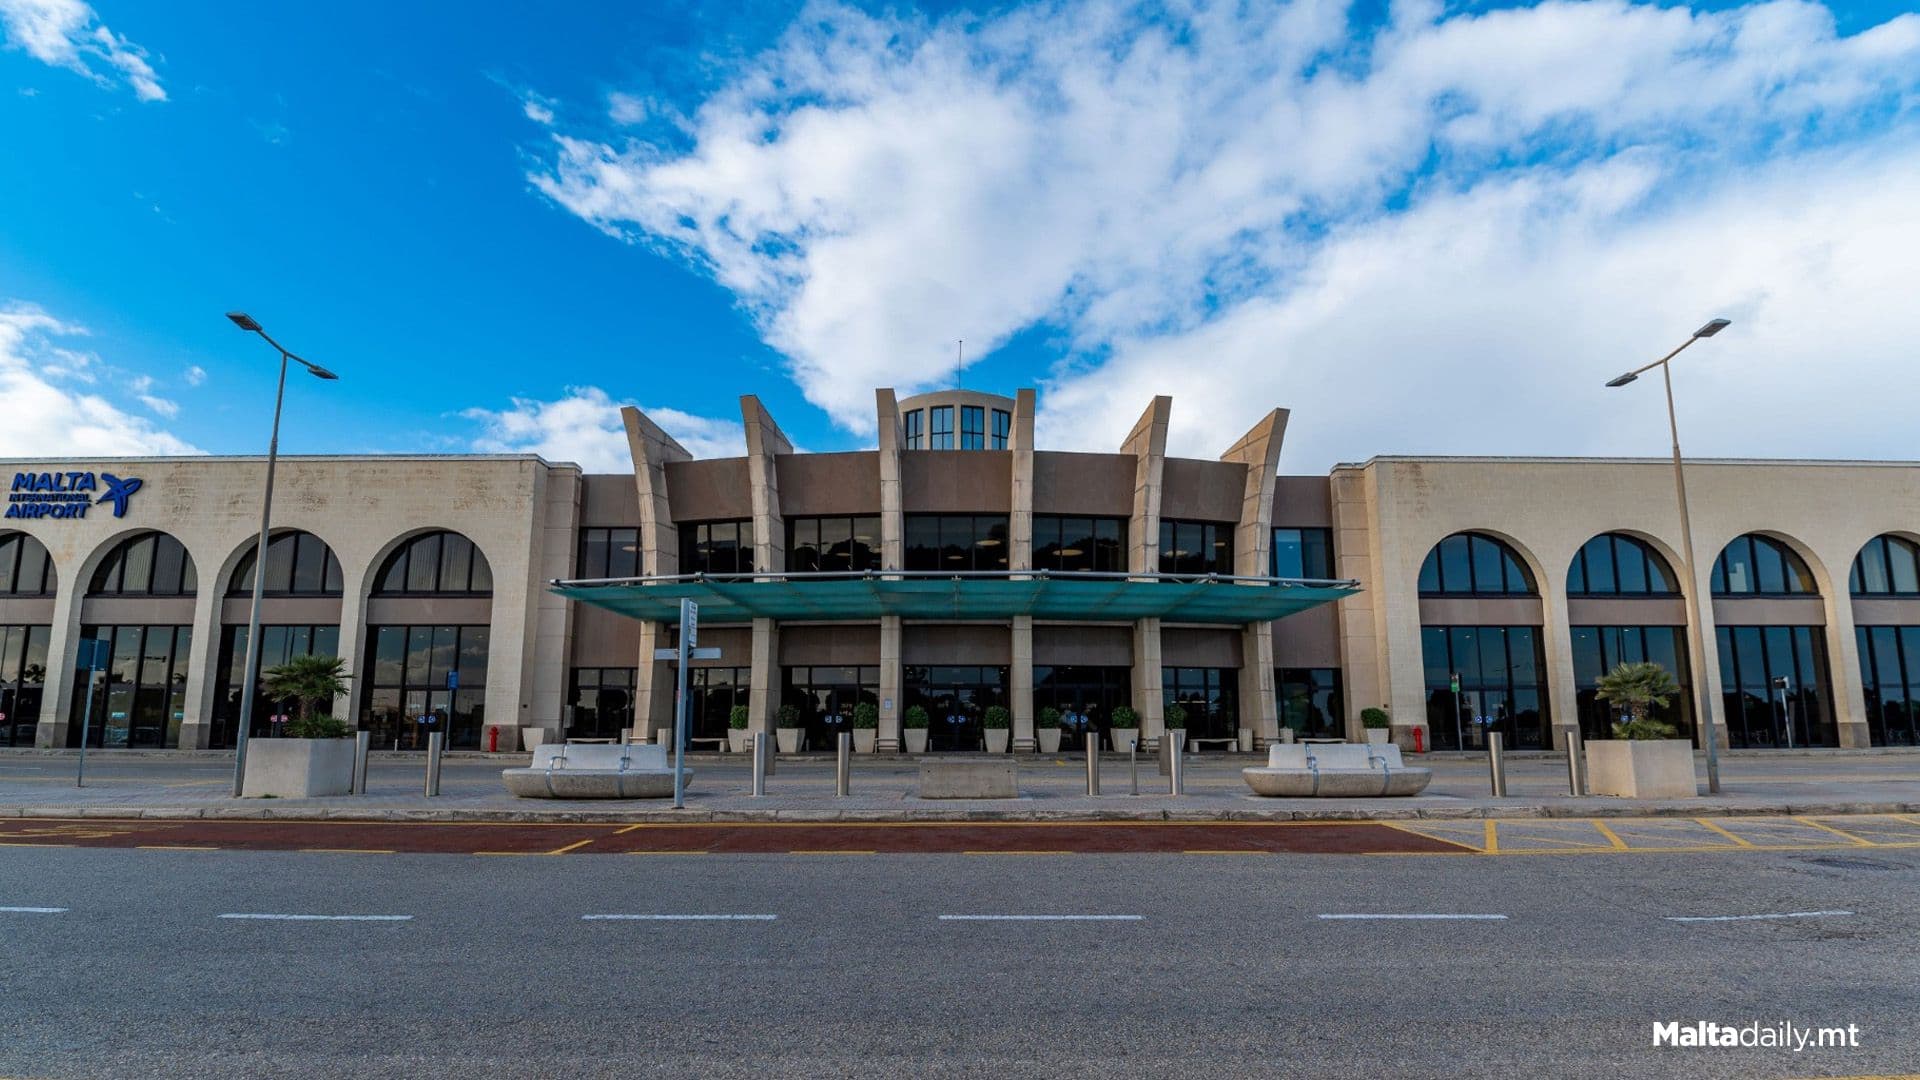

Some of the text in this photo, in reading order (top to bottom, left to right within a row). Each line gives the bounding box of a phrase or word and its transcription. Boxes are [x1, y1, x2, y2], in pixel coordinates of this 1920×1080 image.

[11, 472, 96, 491] MALTA
[9, 493, 91, 502] INTERNATIONAL
[4, 503, 91, 518] AIRPORT
